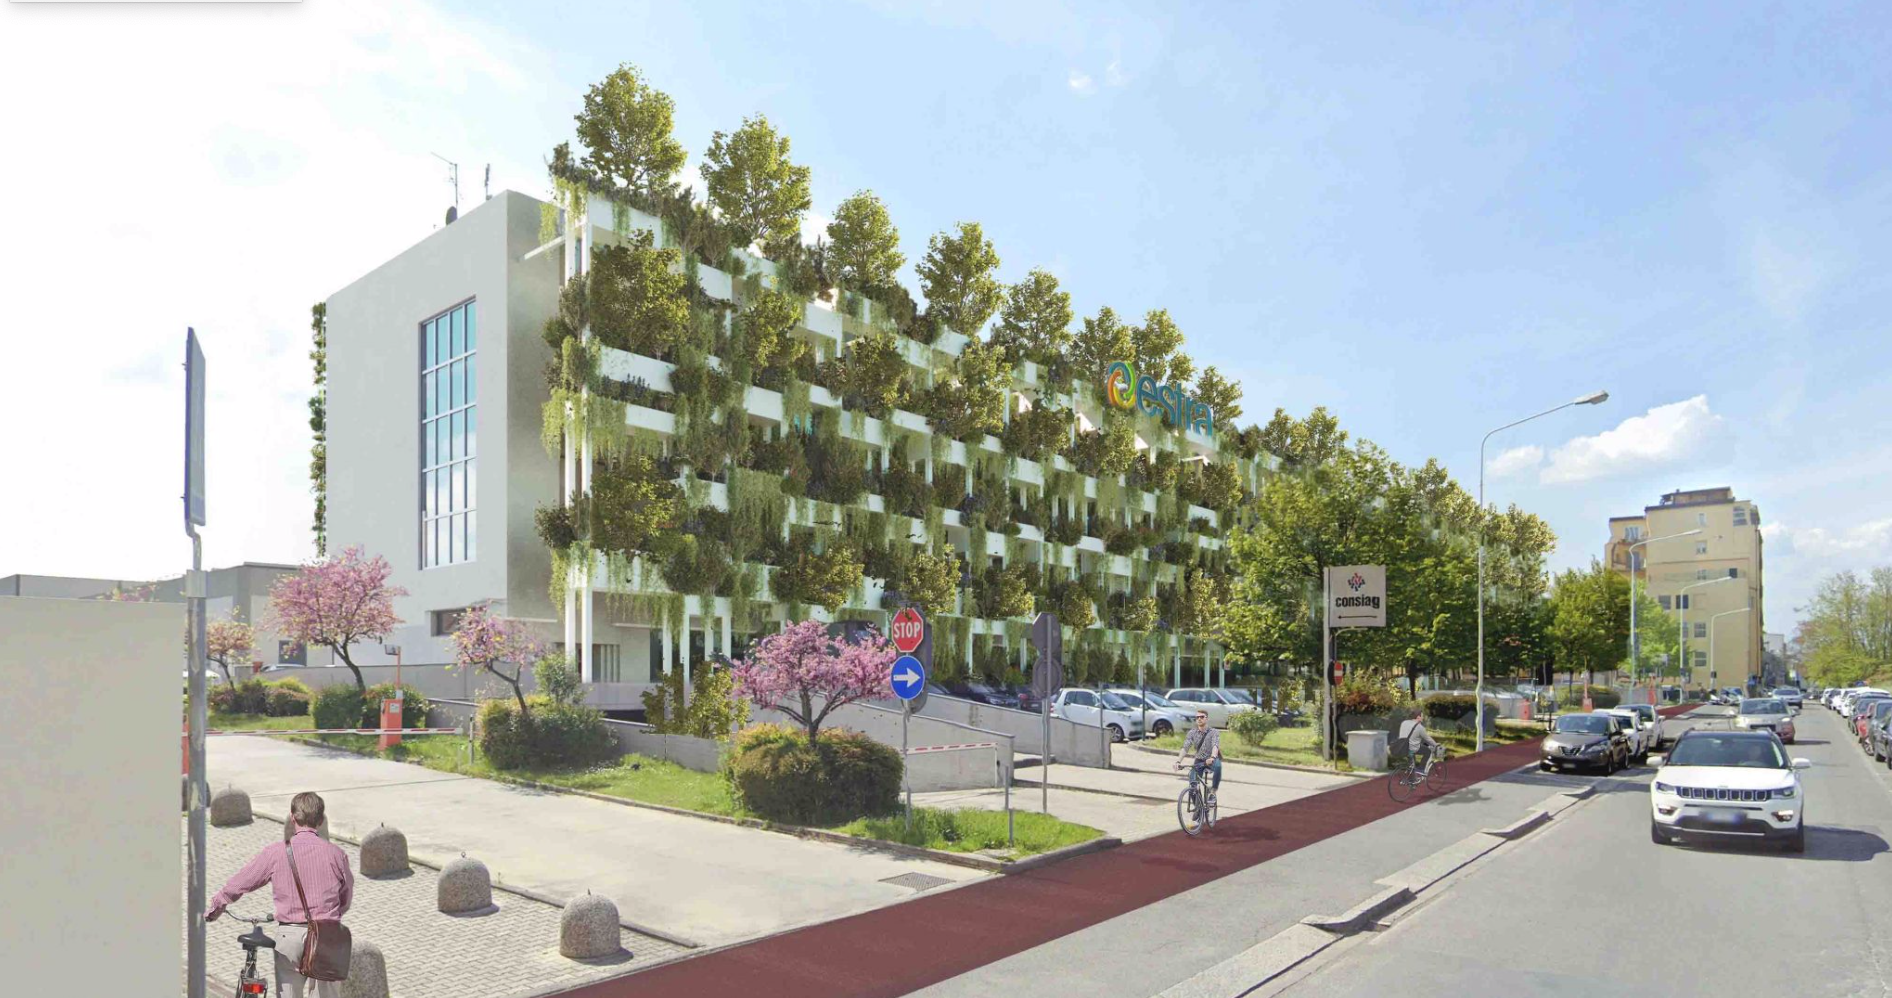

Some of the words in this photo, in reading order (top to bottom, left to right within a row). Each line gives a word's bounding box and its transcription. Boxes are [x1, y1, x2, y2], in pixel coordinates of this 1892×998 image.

[1137, 375, 1213, 437] estra
[1335, 594, 1380, 609] consiag
[893, 621, 921, 638] STOP
